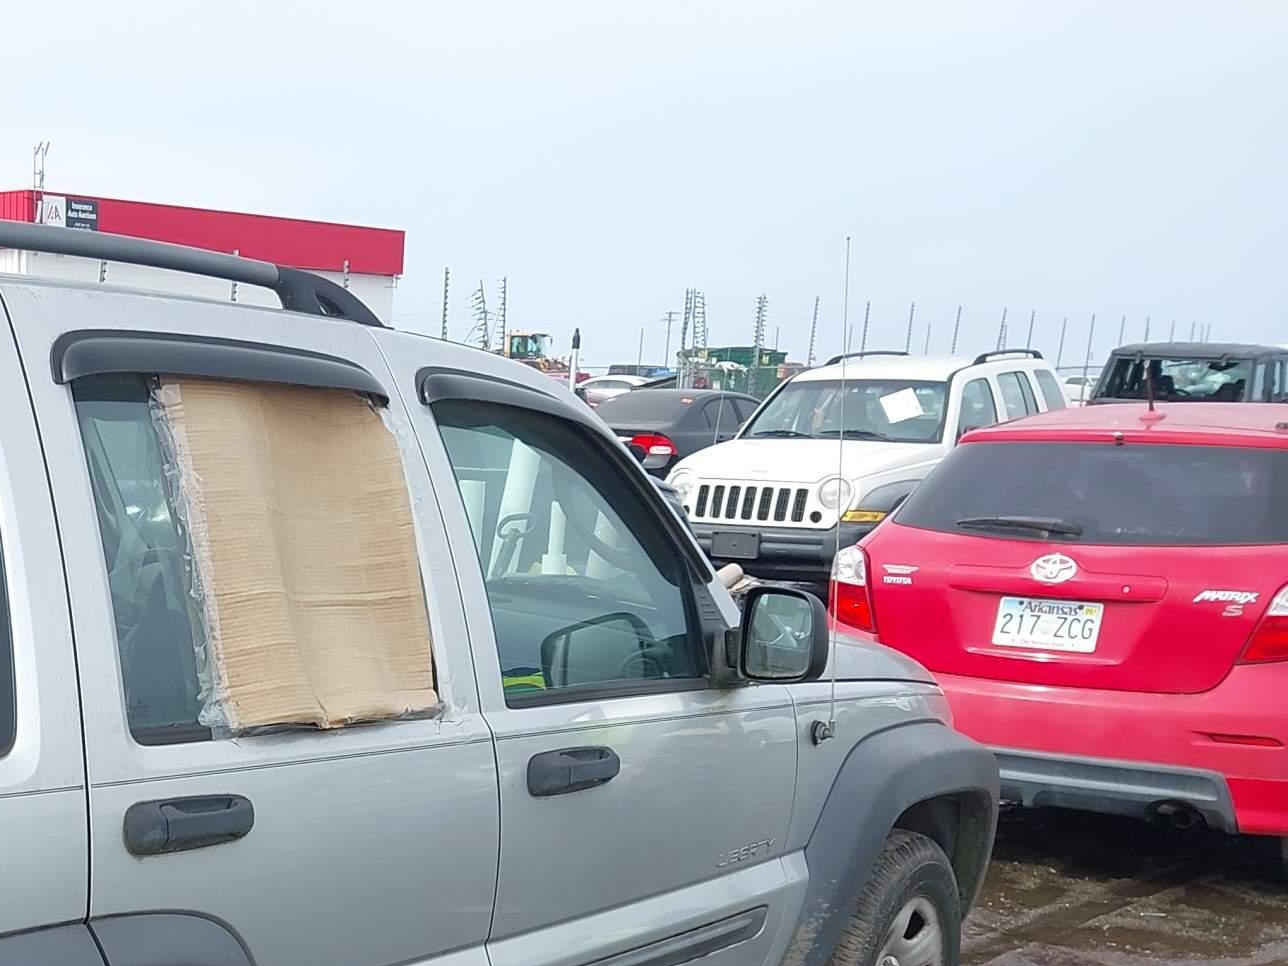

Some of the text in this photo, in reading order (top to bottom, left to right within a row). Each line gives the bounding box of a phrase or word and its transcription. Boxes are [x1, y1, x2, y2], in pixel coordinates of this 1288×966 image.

[883, 575, 913, 585] TOYOTA
[1193, 590, 1259, 604] MATRIX
[1022, 601, 1079, 616] Arkansas
[1222, 604, 1244, 616] S
[1000, 613, 1095, 640] 217 ZCG
